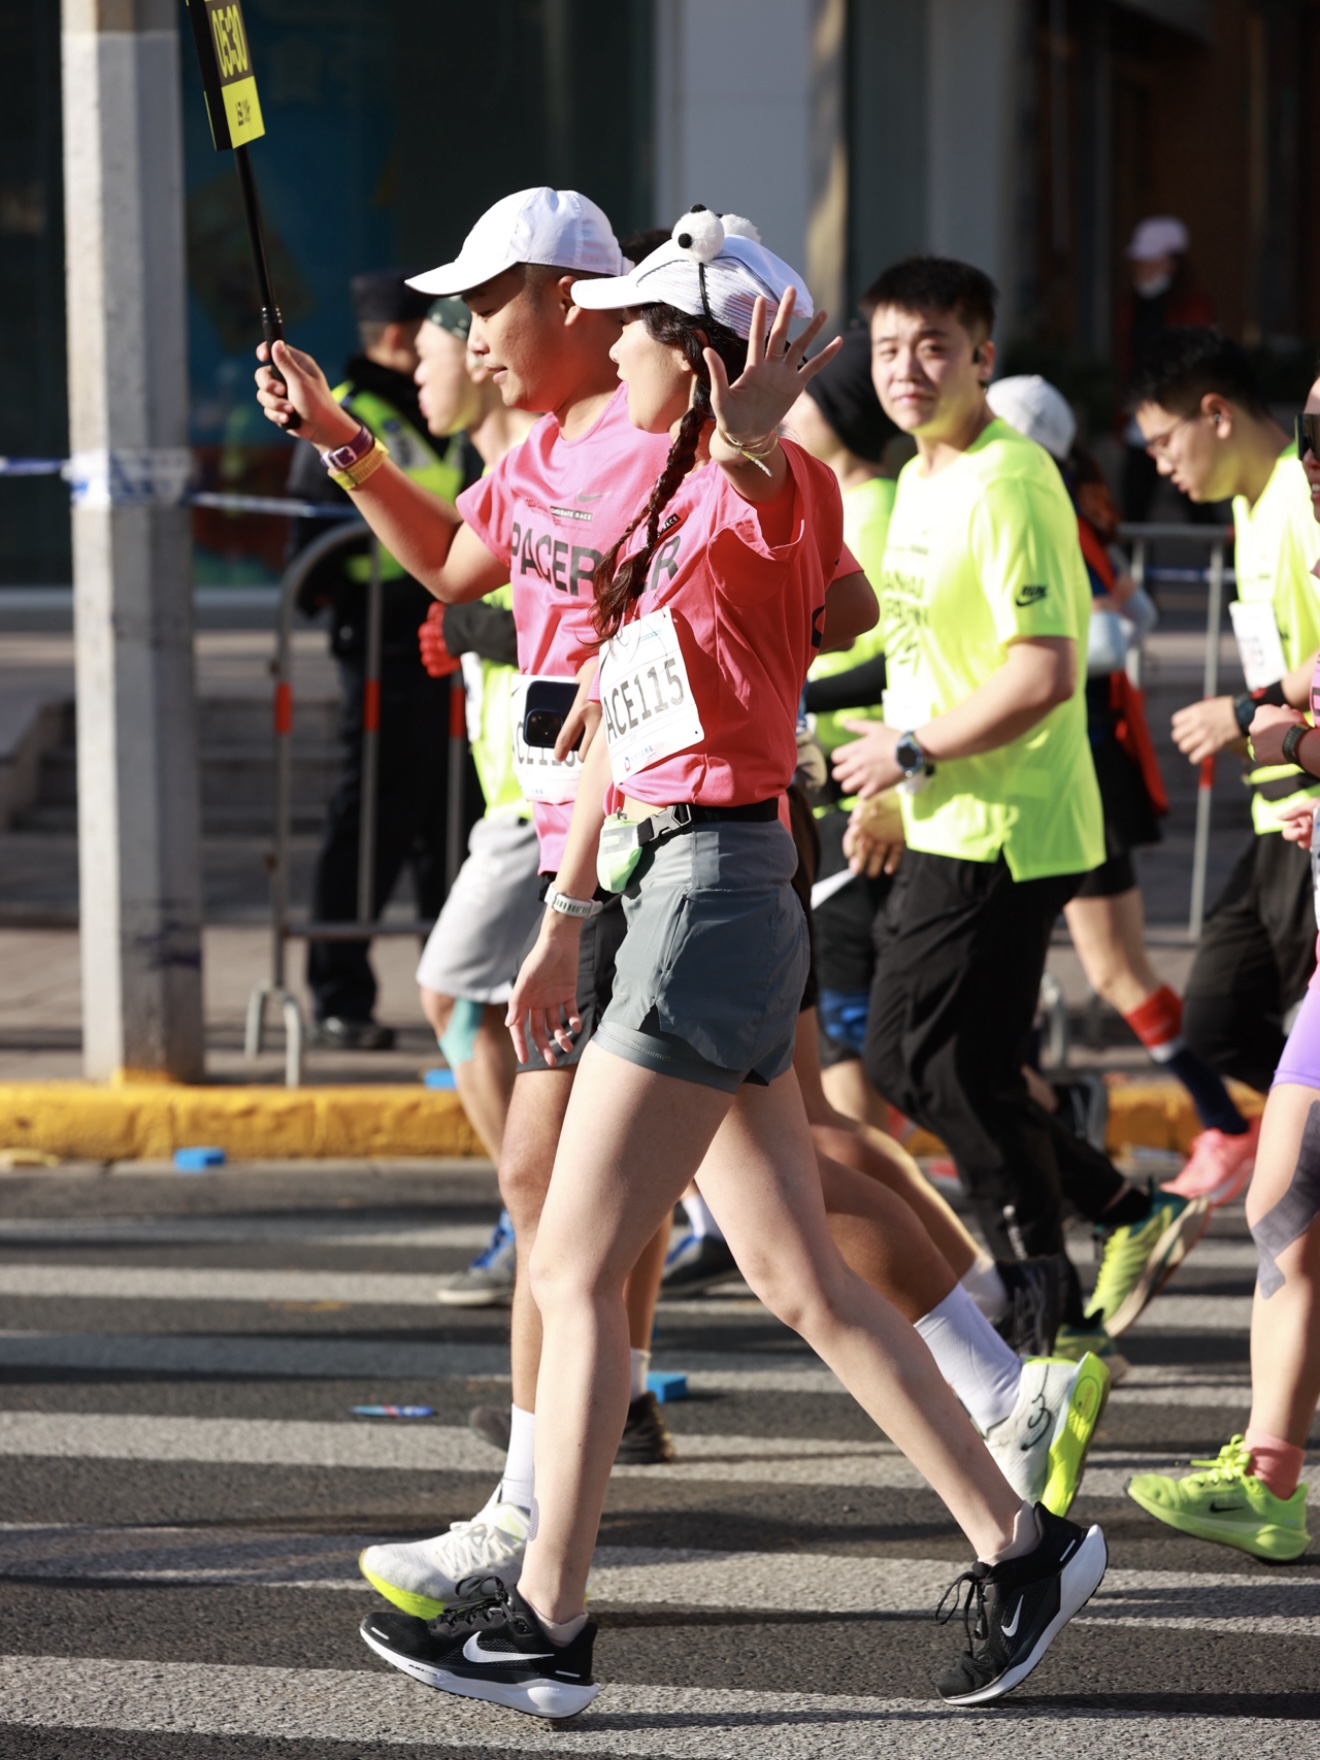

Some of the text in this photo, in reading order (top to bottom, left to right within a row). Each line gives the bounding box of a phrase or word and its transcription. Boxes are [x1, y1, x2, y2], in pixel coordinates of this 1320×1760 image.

[211, 4, 248, 78] 05:30
[575, 510, 593, 521] RACE
[511, 521, 604, 596] PACER
